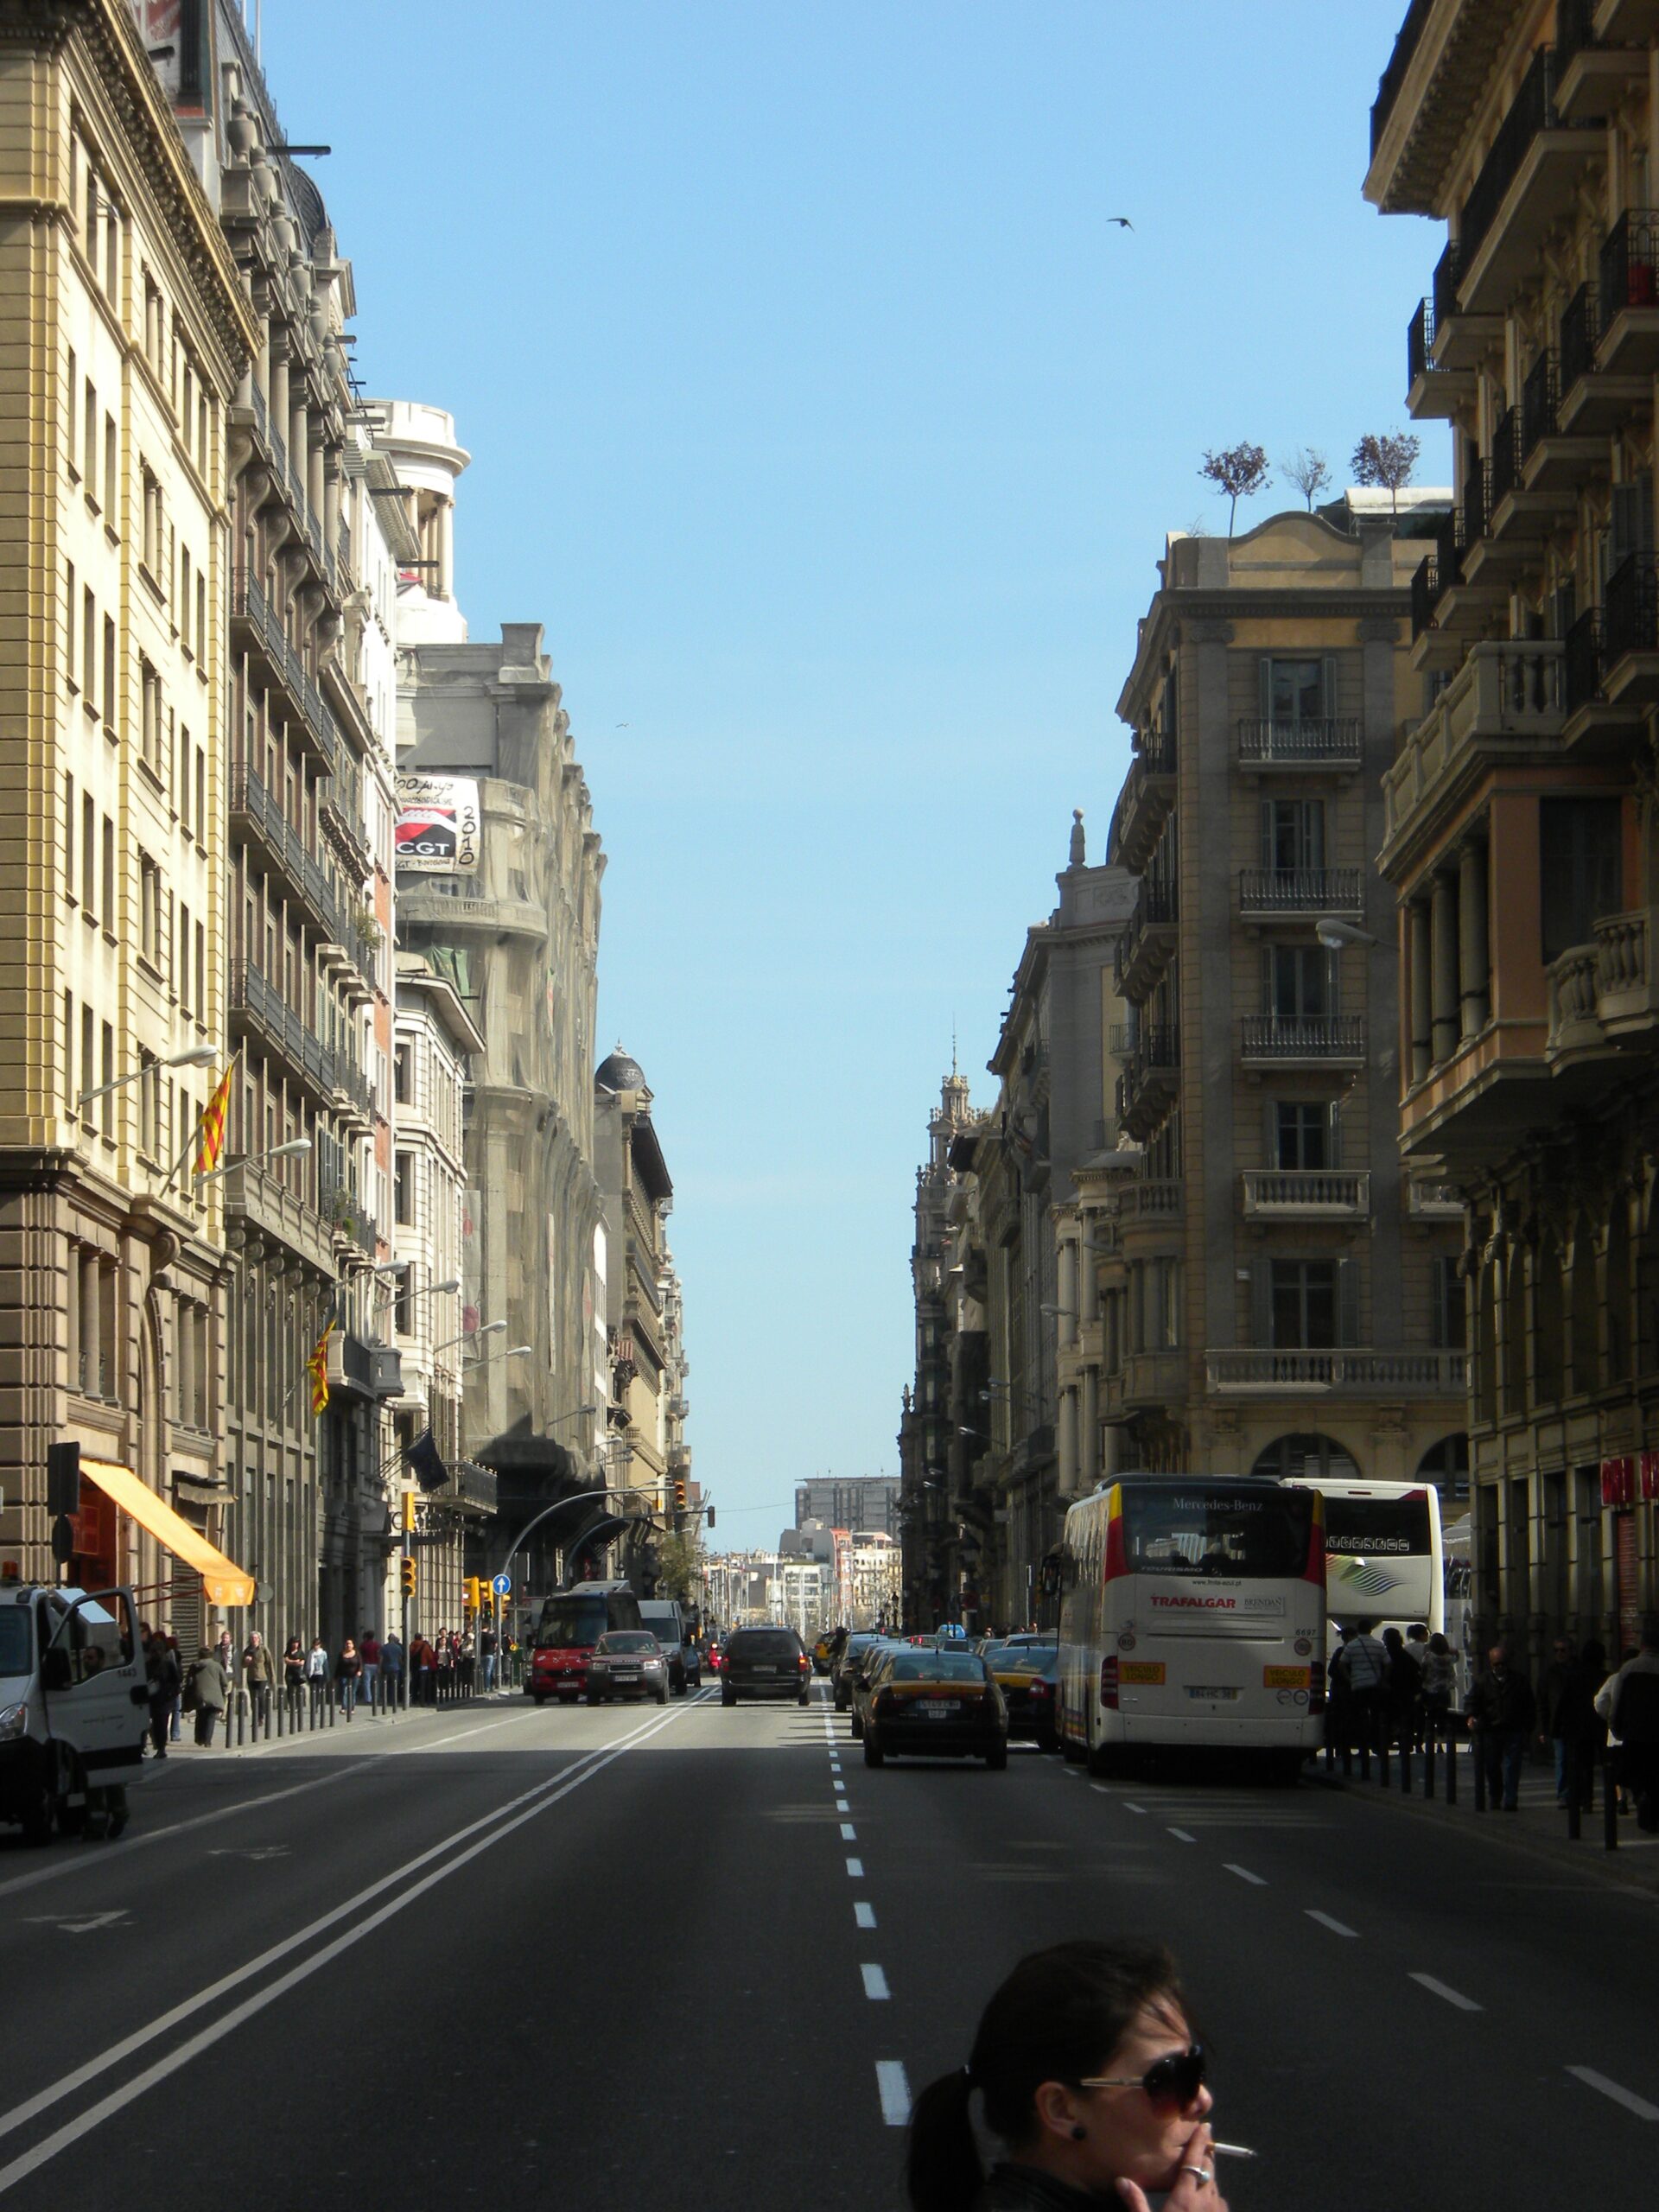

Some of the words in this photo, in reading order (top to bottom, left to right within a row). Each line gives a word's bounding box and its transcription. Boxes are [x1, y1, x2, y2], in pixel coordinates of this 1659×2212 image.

[459, 805, 476, 865] 2010
[396, 842, 449, 855] CGT
[1173, 1497, 1263, 1512] Mercedes-Benz
[1150, 1596, 1236, 1609] TRAFALGAR
